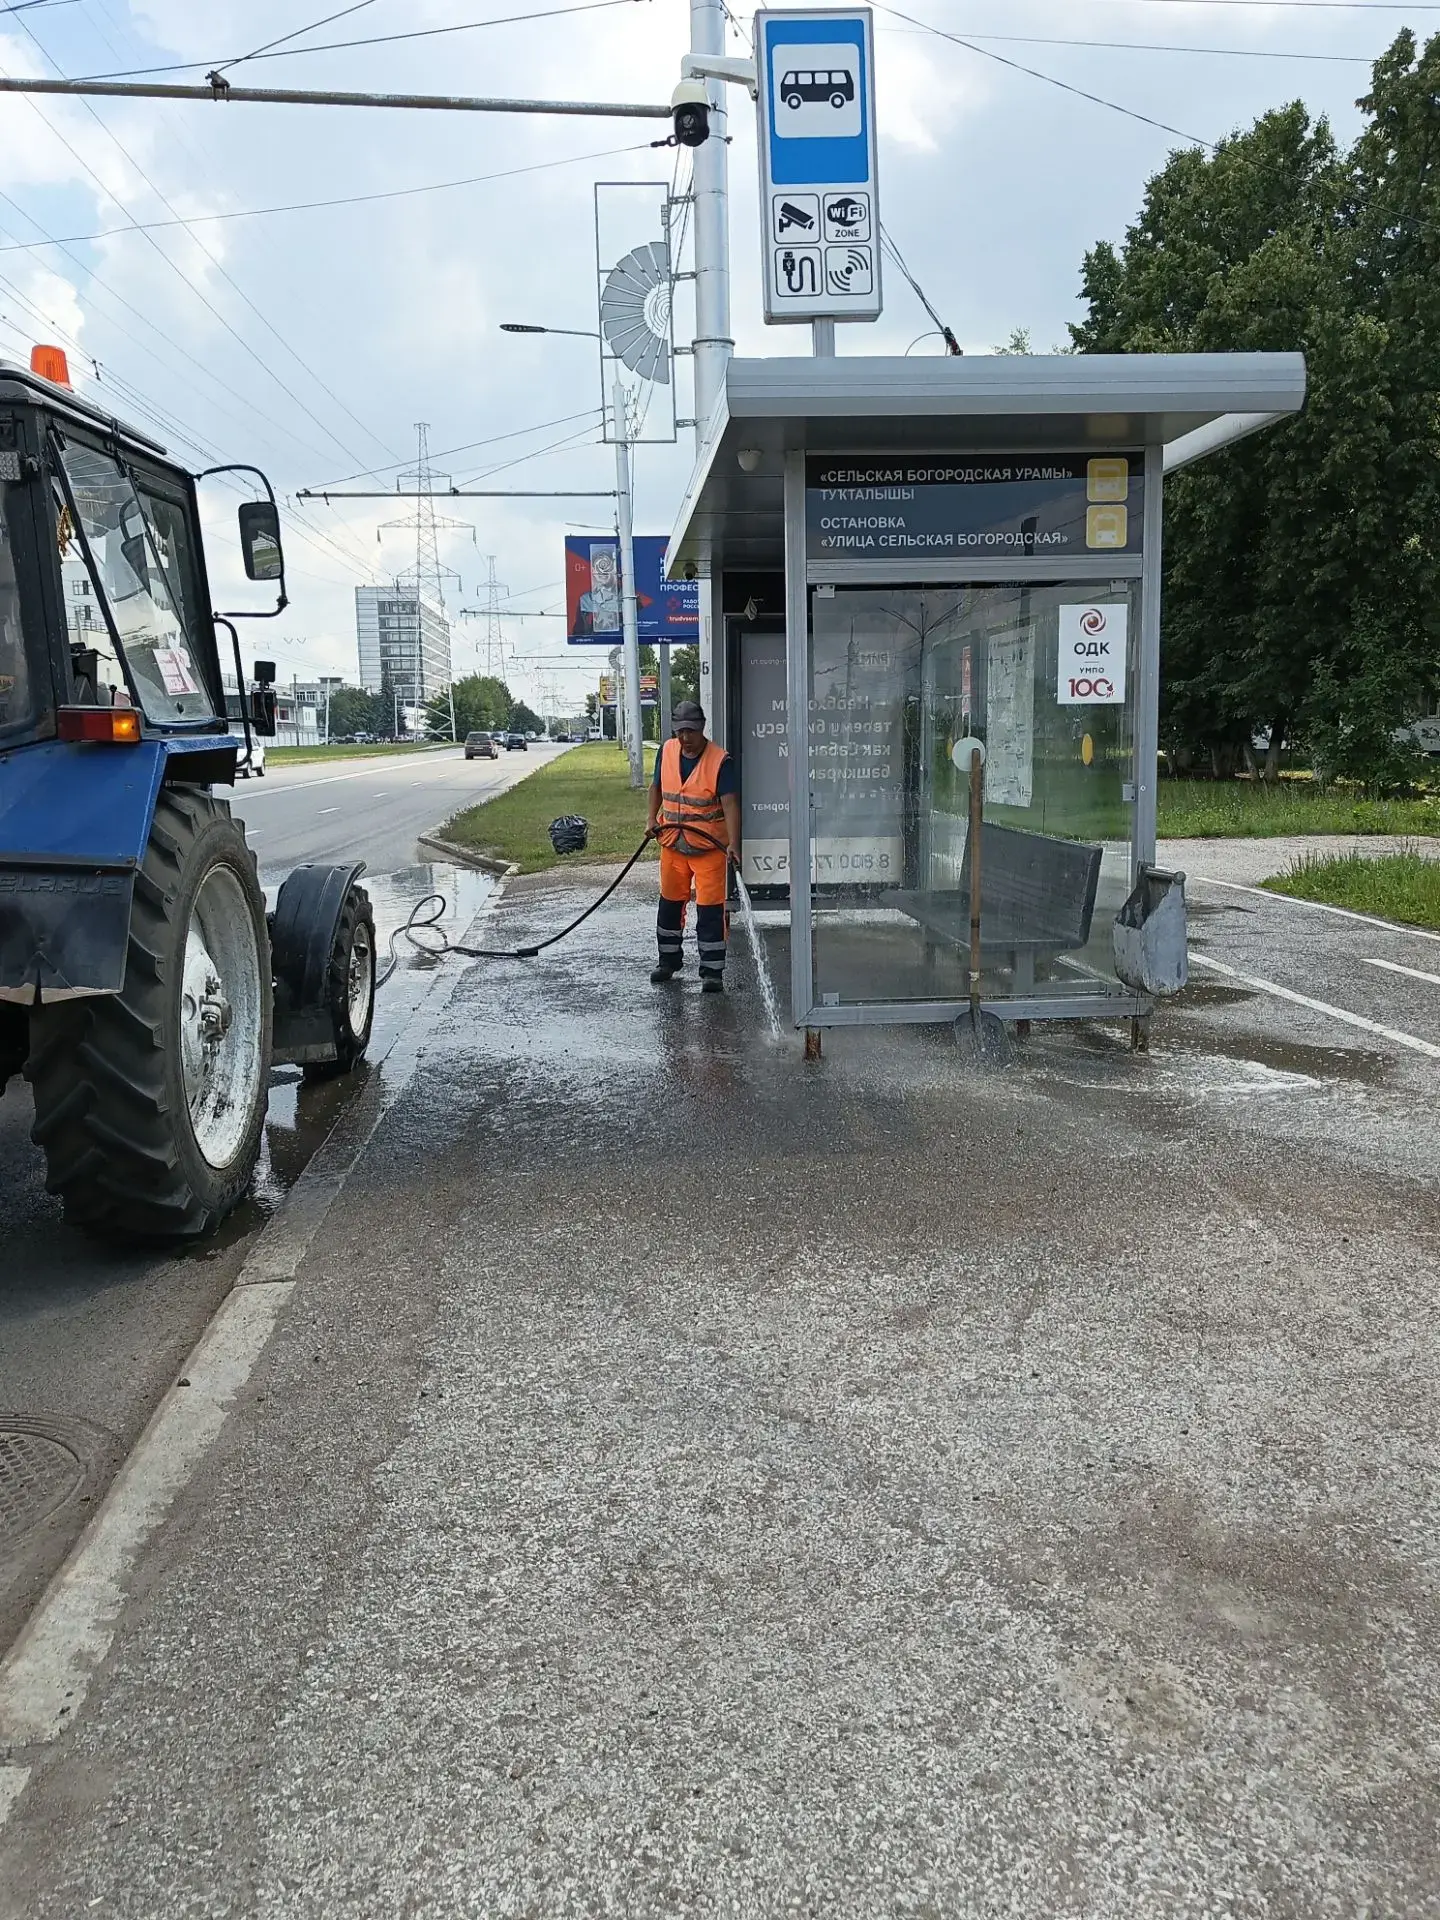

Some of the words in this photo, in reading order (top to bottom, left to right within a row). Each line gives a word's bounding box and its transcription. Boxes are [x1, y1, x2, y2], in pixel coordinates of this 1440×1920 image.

[835, 229, 860, 237] ZONE
[820, 470, 902, 482] «СЕЛЬСКАЯ
[907, 468, 1011, 482] БОГОРОДСКАЯ
[1016, 467, 1073, 480] УРАМЫ»
[820, 517, 906, 529] ОСТАНОВКА
[821, 535, 875, 548] «УЛИЦА
[879, 534, 953, 546] СЕЛЬСКАЯ
[958, 532, 1068, 546] БОГОРОДСКАЯ»
[575, 563, 586, 572] 0+
[1074, 642, 1110, 656] ОДК
[1068, 678, 1111, 697] 100
